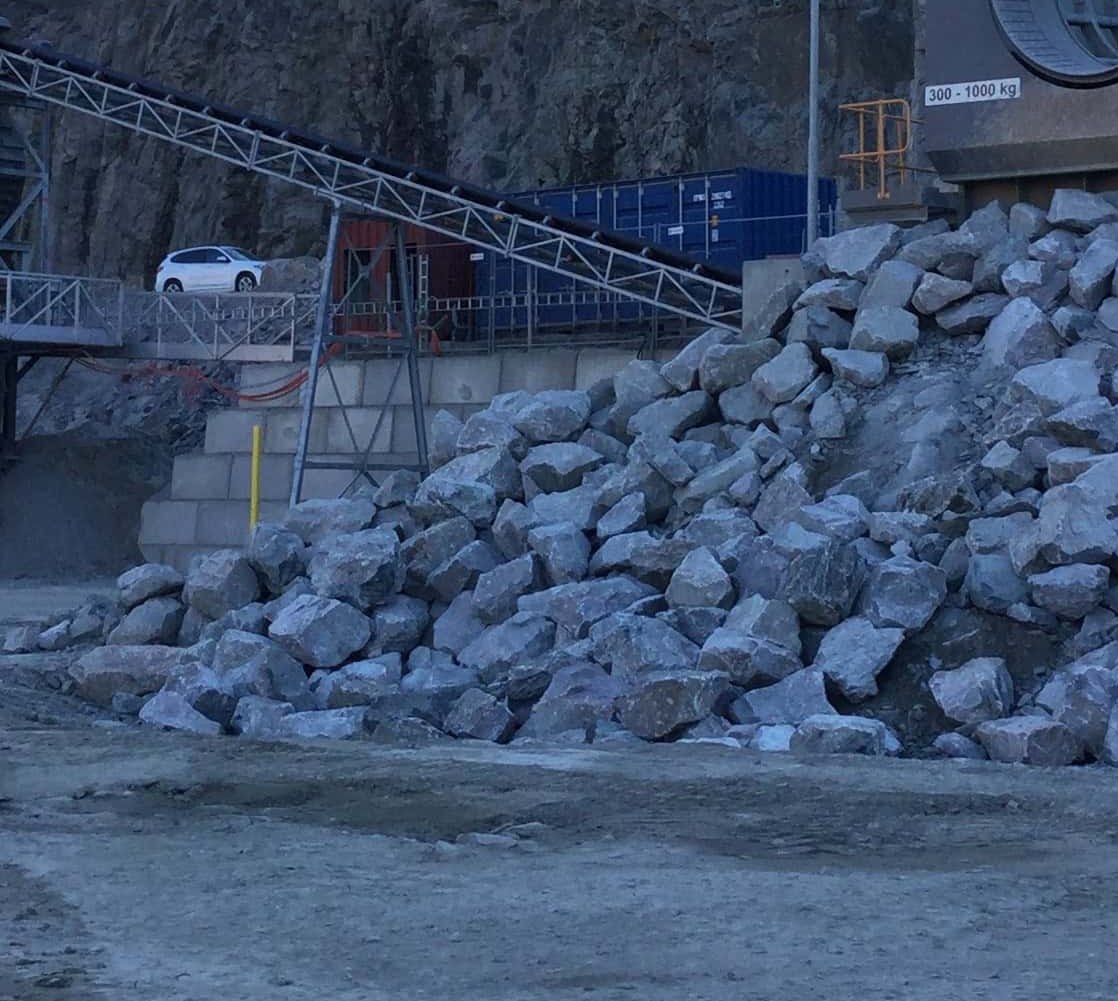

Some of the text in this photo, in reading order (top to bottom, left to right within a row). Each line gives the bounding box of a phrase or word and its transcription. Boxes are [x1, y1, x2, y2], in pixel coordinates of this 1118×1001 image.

[929, 88, 951, 101] 300
[966, 83, 996, 98] 1000
[1000, 82, 1017, 98] kg
